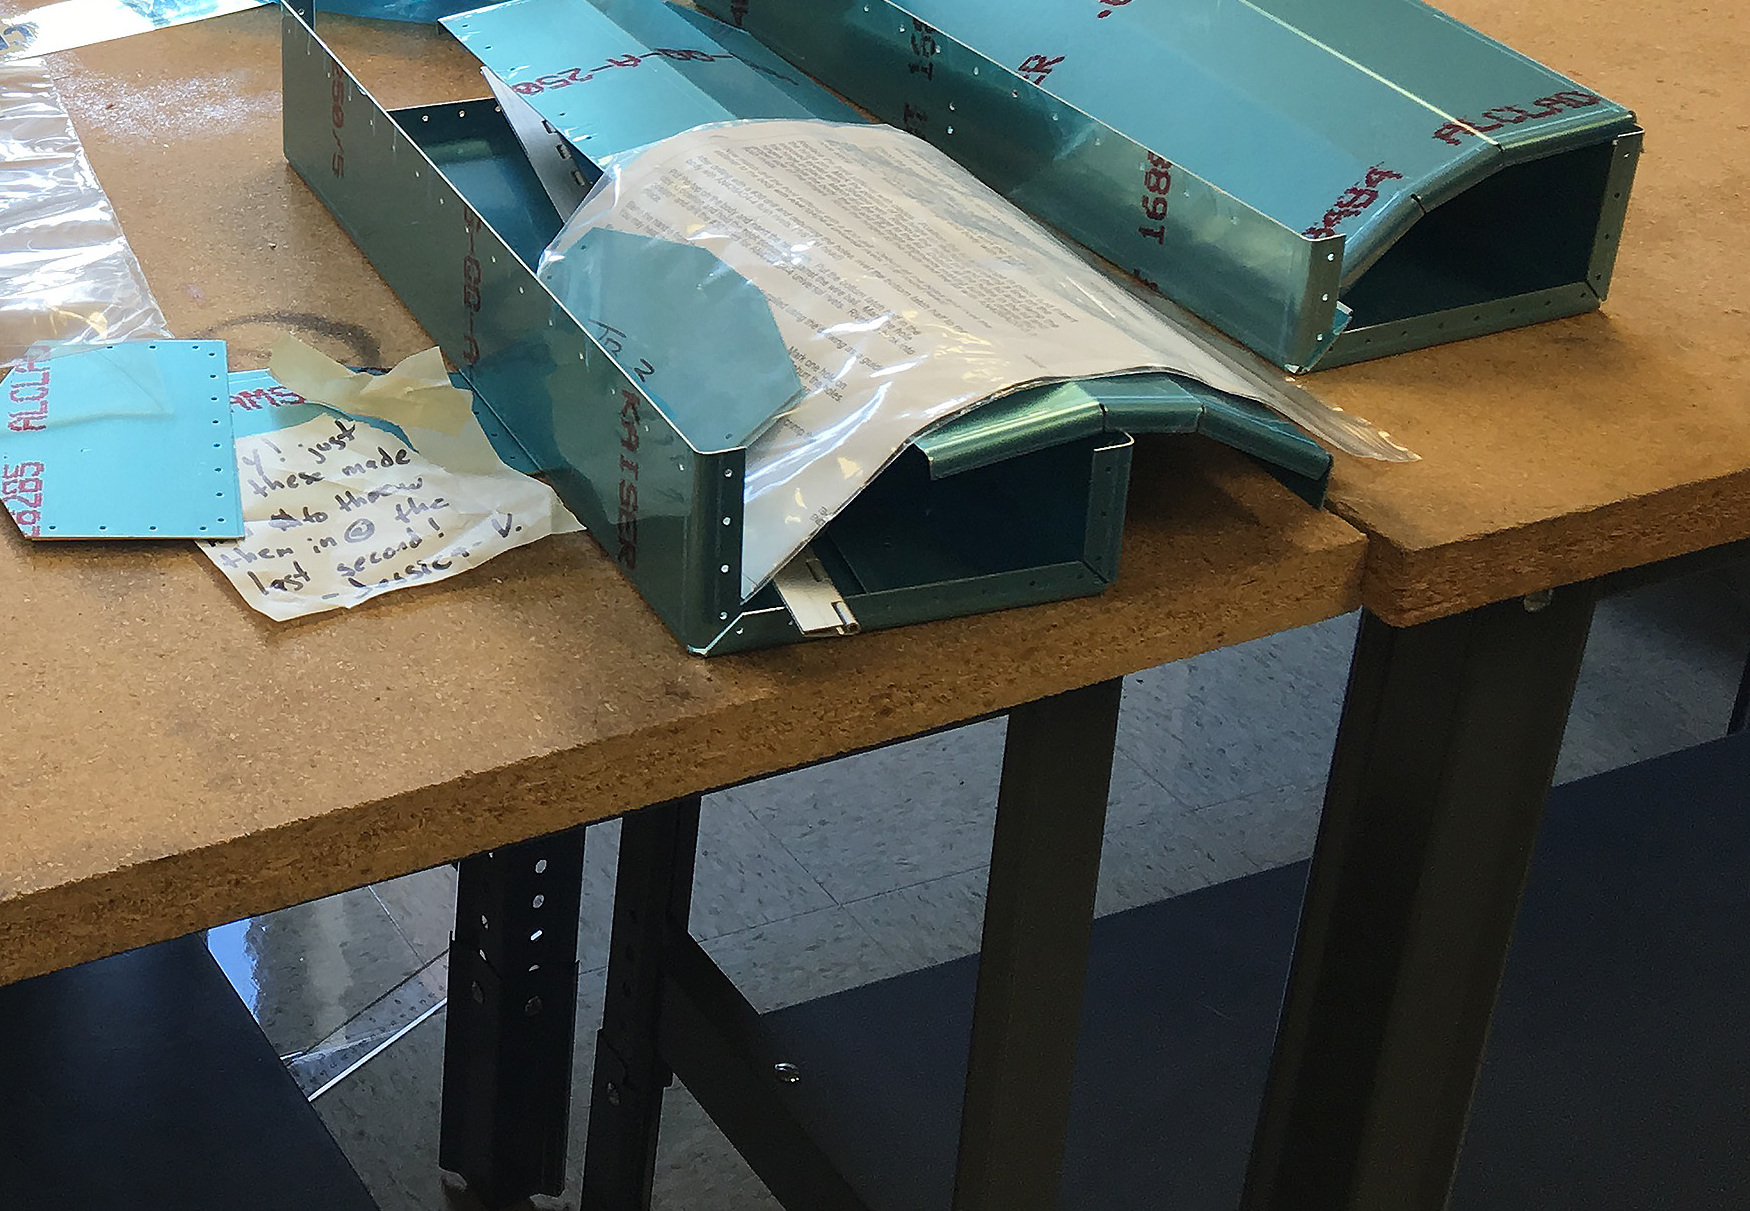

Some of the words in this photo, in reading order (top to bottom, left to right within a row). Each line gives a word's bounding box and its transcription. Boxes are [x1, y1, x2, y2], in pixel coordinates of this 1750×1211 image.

[633, 358, 655, 383] 2
[341, 446, 411, 477] made
[617, 389, 642, 571] KAISER
[302, 506, 329, 524] to
[306, 534, 338, 554] in
[394, 496, 450, 524] the
[247, 560, 311, 596] last
